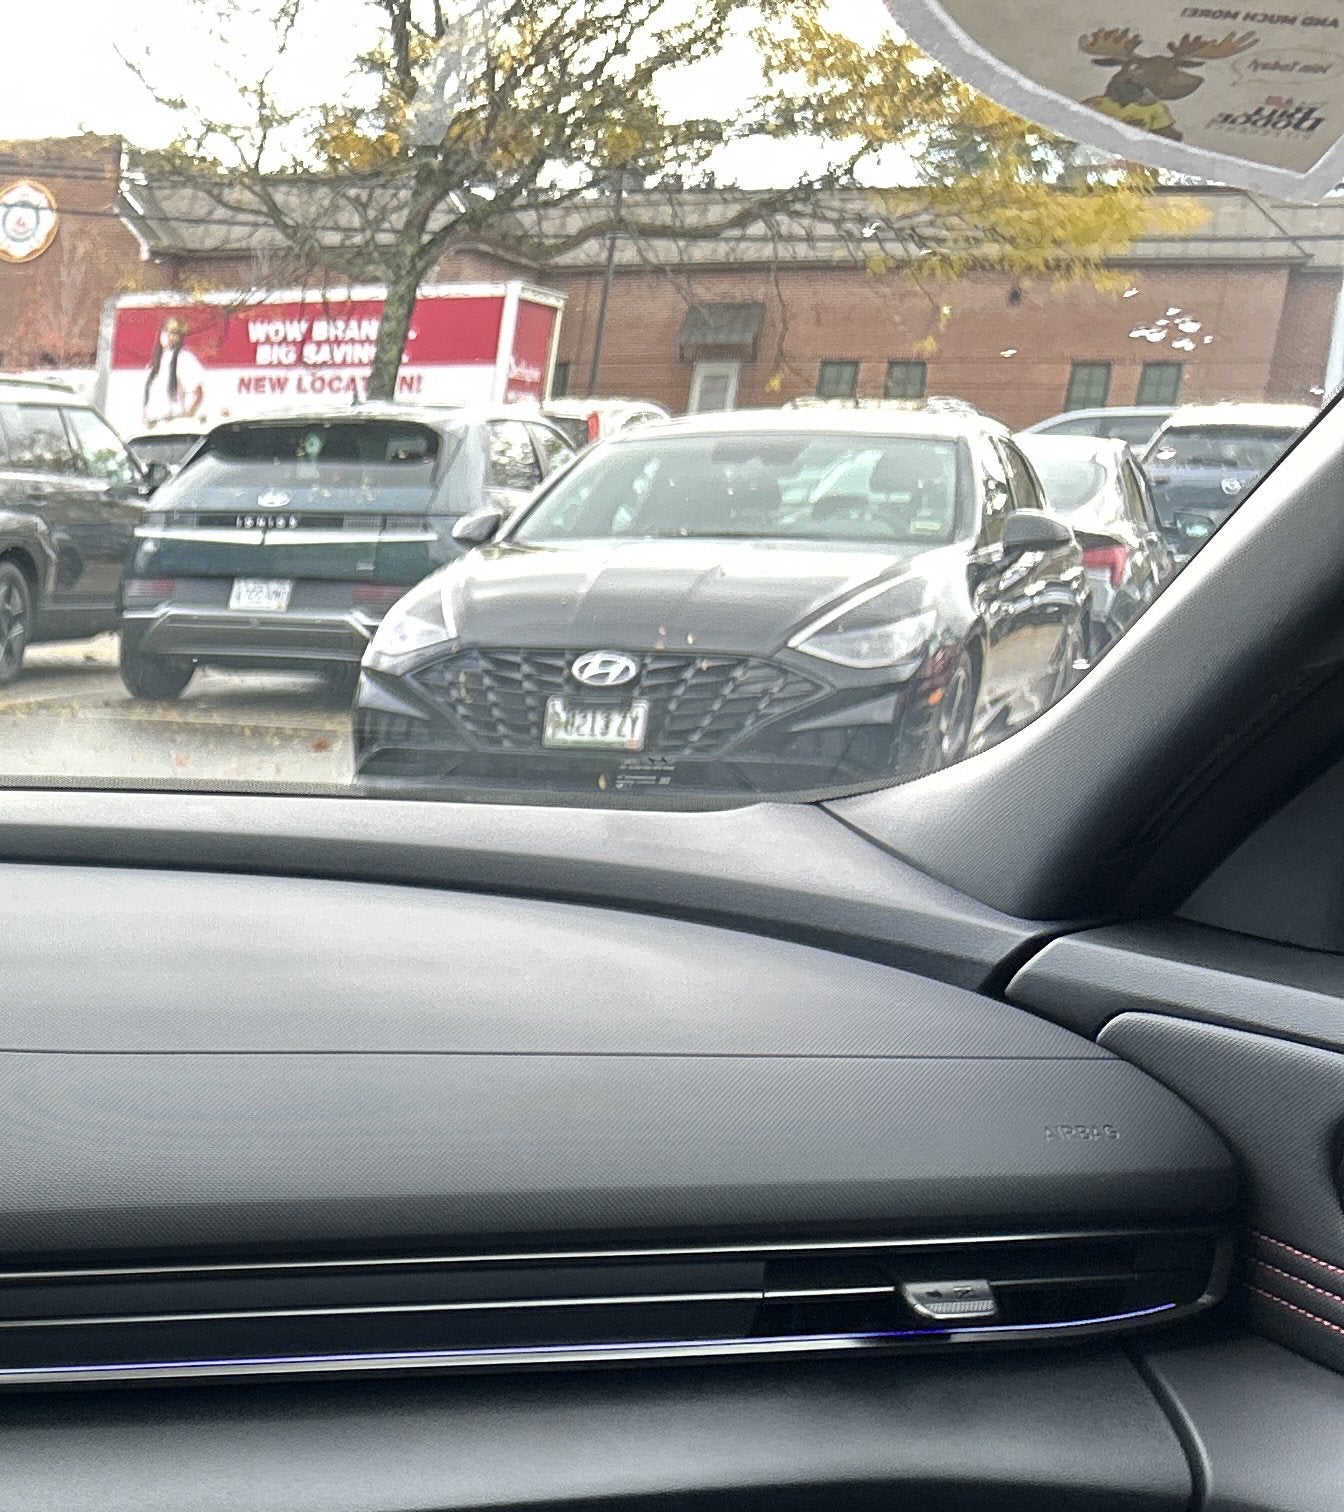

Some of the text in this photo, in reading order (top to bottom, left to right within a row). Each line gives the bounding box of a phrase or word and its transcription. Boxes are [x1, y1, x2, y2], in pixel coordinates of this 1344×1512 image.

[248, 318, 417, 343] WOW BRAN.
[256, 344, 297, 365] BIG
[238, 374, 424, 396] NEW LOCATN!
[1043, 1123, 1121, 1142] AIRBAG
